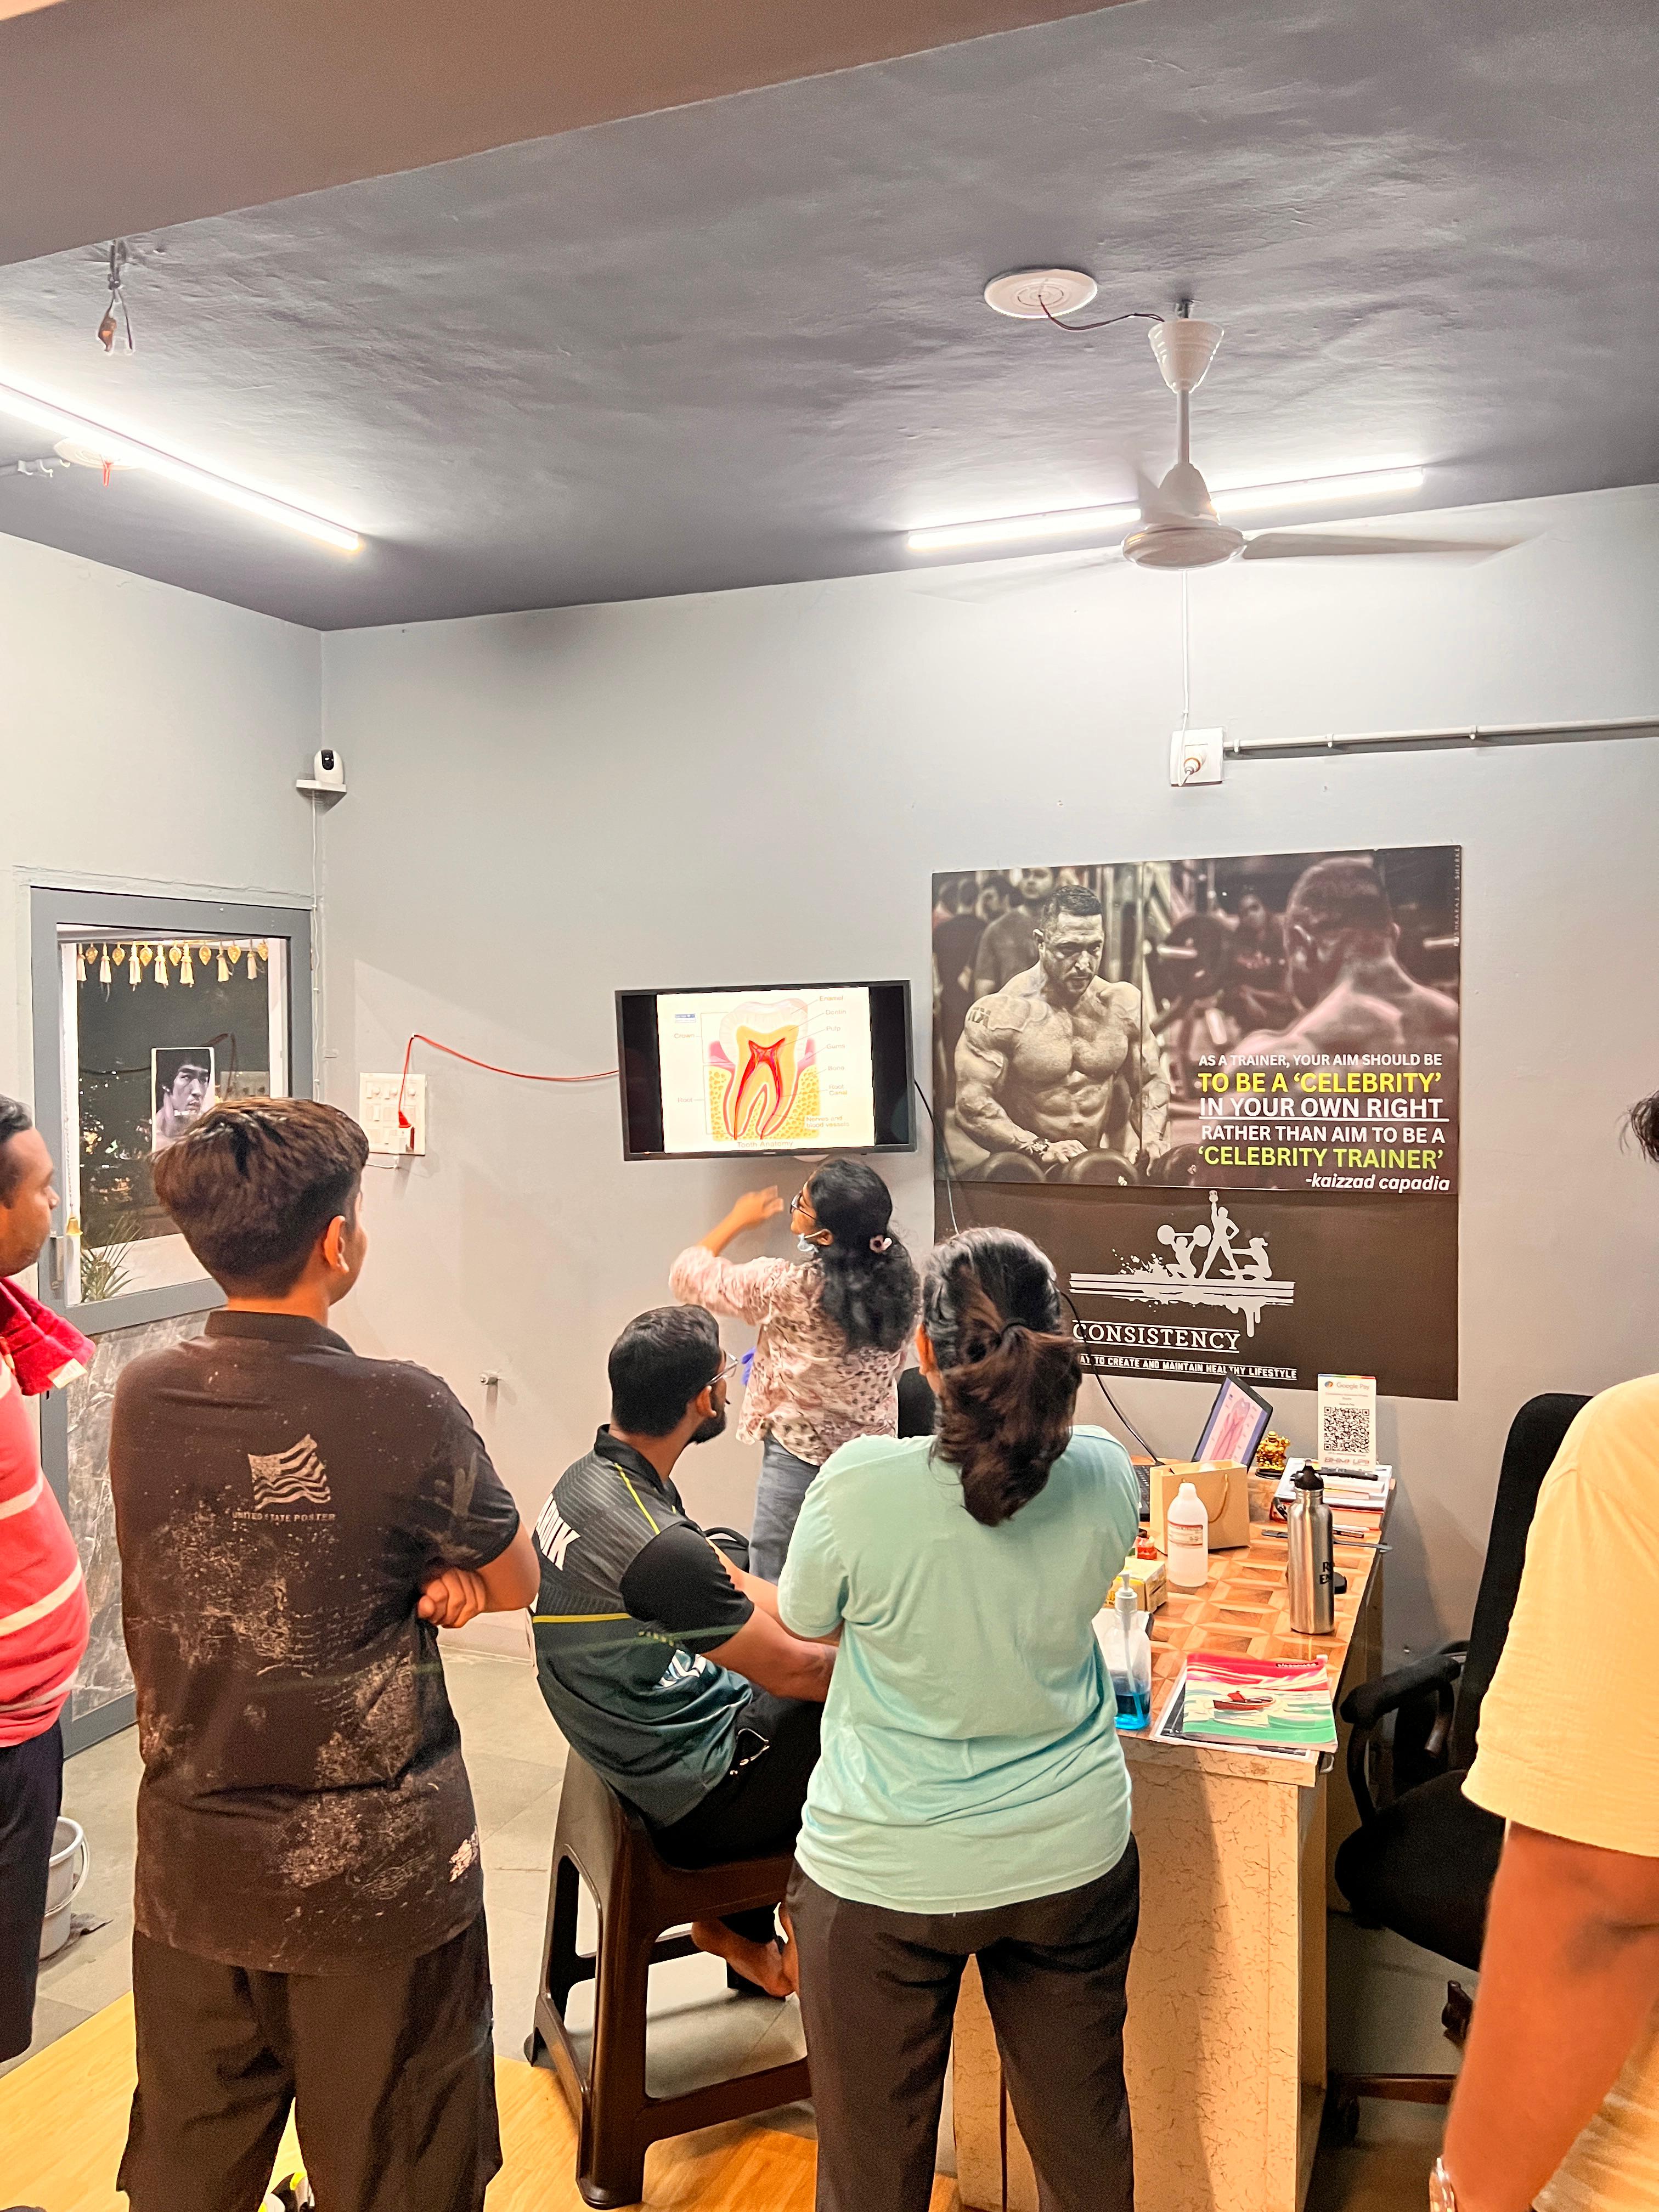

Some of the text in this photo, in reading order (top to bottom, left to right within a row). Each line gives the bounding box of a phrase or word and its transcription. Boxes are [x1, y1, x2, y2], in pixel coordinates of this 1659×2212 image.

[1199, 1053, 1442, 1068] AS A TRAINER, YOUR AIM SHOULD BE
[1198, 1072, 1229, 1093] TO
[1236, 1073, 1266, 1092] BE
[1271, 1073, 1288, 1092] A
[1200, 1097, 1443, 1118] IN YOUR OWN RIGHT
[1201, 1125, 1445, 1143] RATHER THAN AIM TO BE A
[1305, 1173, 1451, 1194] -kaizzad capadia
[1073, 1323, 1241, 1350] CONSISTENCY
[1080, 1355, 1090, 1364] AY
[1094, 1356, 1105, 1365] TO
[1108, 1357, 1139, 1368] CREATE
[1142, 1359, 1160, 1369] AND
[1162, 1361, 1204, 1373] MAINTAIN
[1249, 1367, 1297, 1379] LIFESTYLE
[232, 1511, 263, 1520] UNITED
[294, 1513, 336, 1521] POSTER
